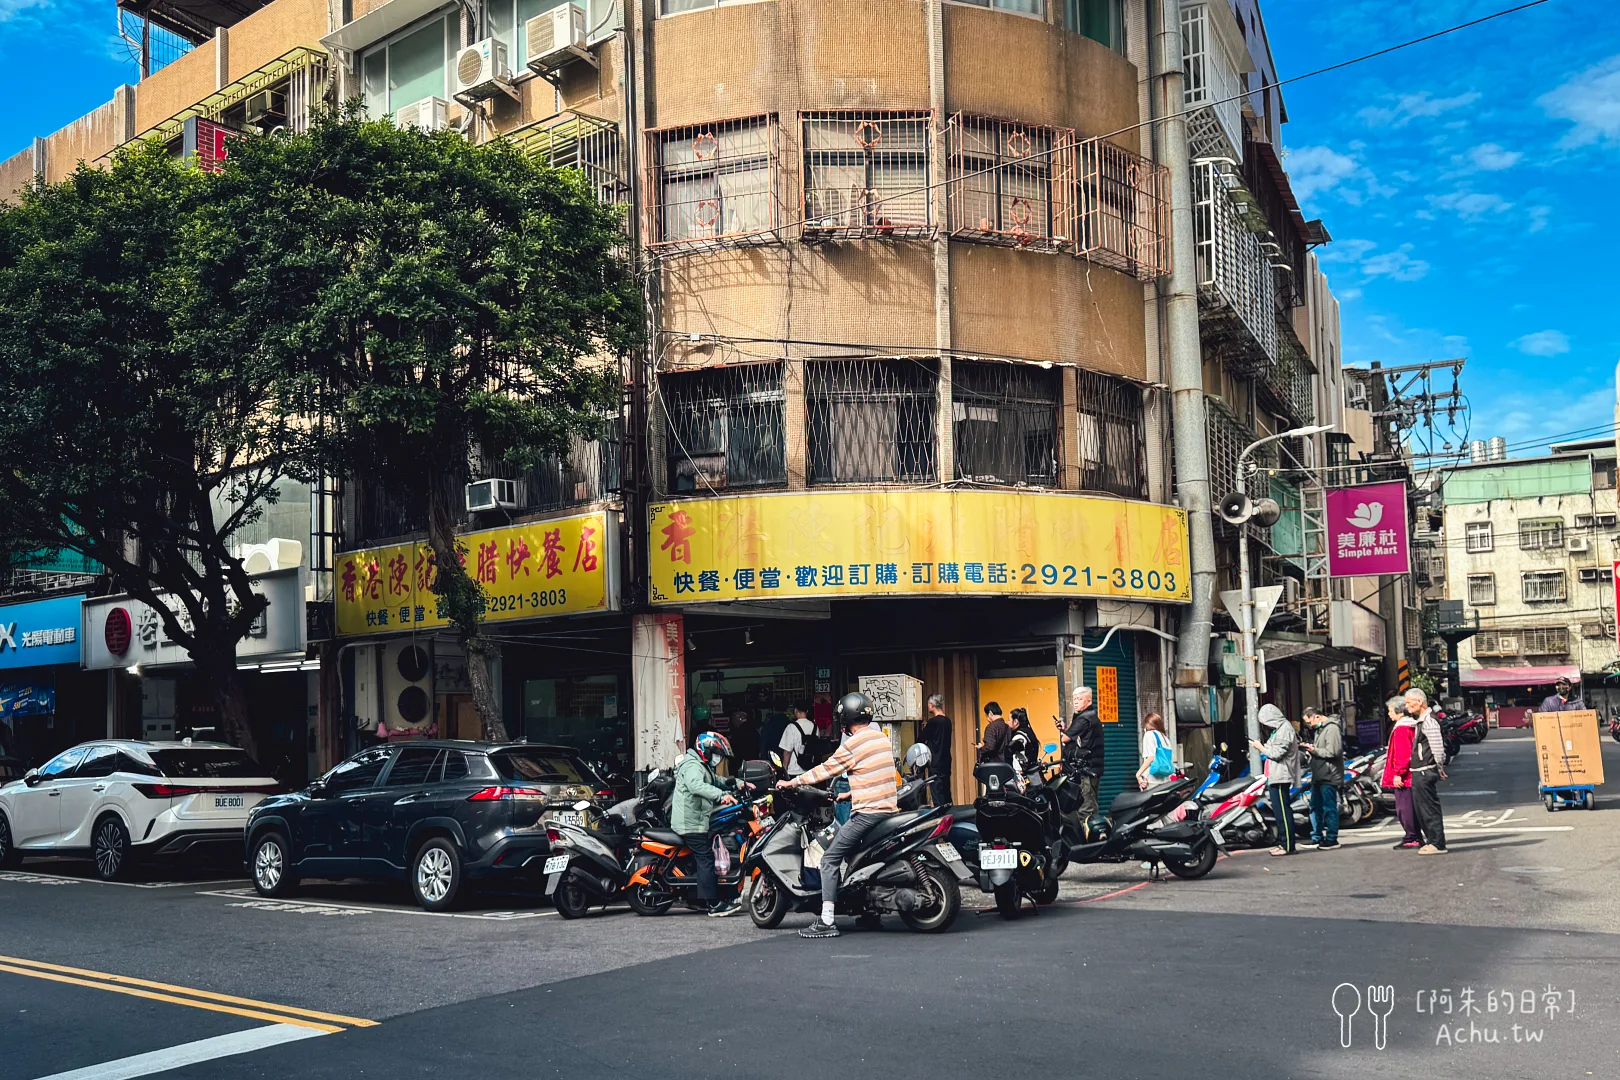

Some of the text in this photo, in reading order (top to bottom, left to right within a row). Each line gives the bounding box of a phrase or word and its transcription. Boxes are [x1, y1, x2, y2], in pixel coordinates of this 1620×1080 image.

[1337, 529, 1397, 549] 美廉社
[1338, 546, 1398, 559] Simple Mart
[22, 626, 76, 647] 光陽電動車
[819, 683, 829, 692] 32
[982, 853, 1016, 865] PEJ-9111
